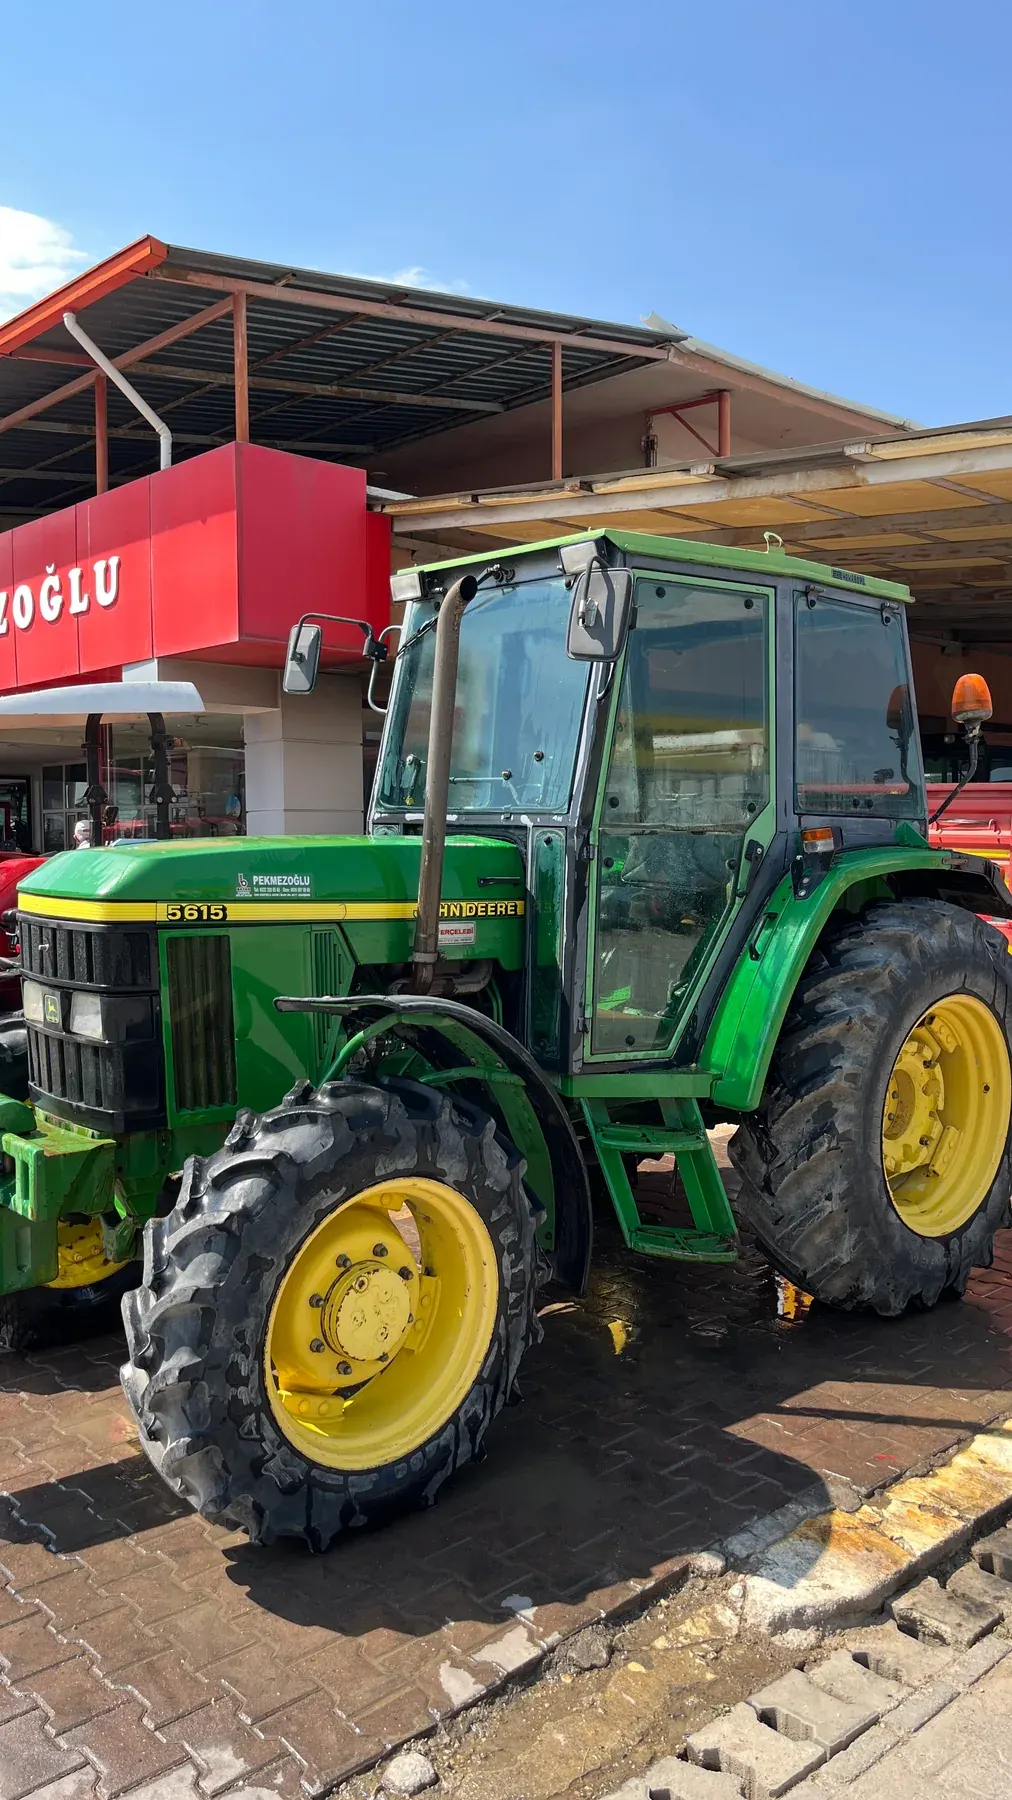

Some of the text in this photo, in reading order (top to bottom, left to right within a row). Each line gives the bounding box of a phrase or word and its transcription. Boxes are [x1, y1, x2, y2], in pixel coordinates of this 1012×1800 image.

[252, 874, 310, 886] PEKMEZOĞLU
[167, 904, 226, 920] 5615
[466, 902, 517, 917] DEERE
